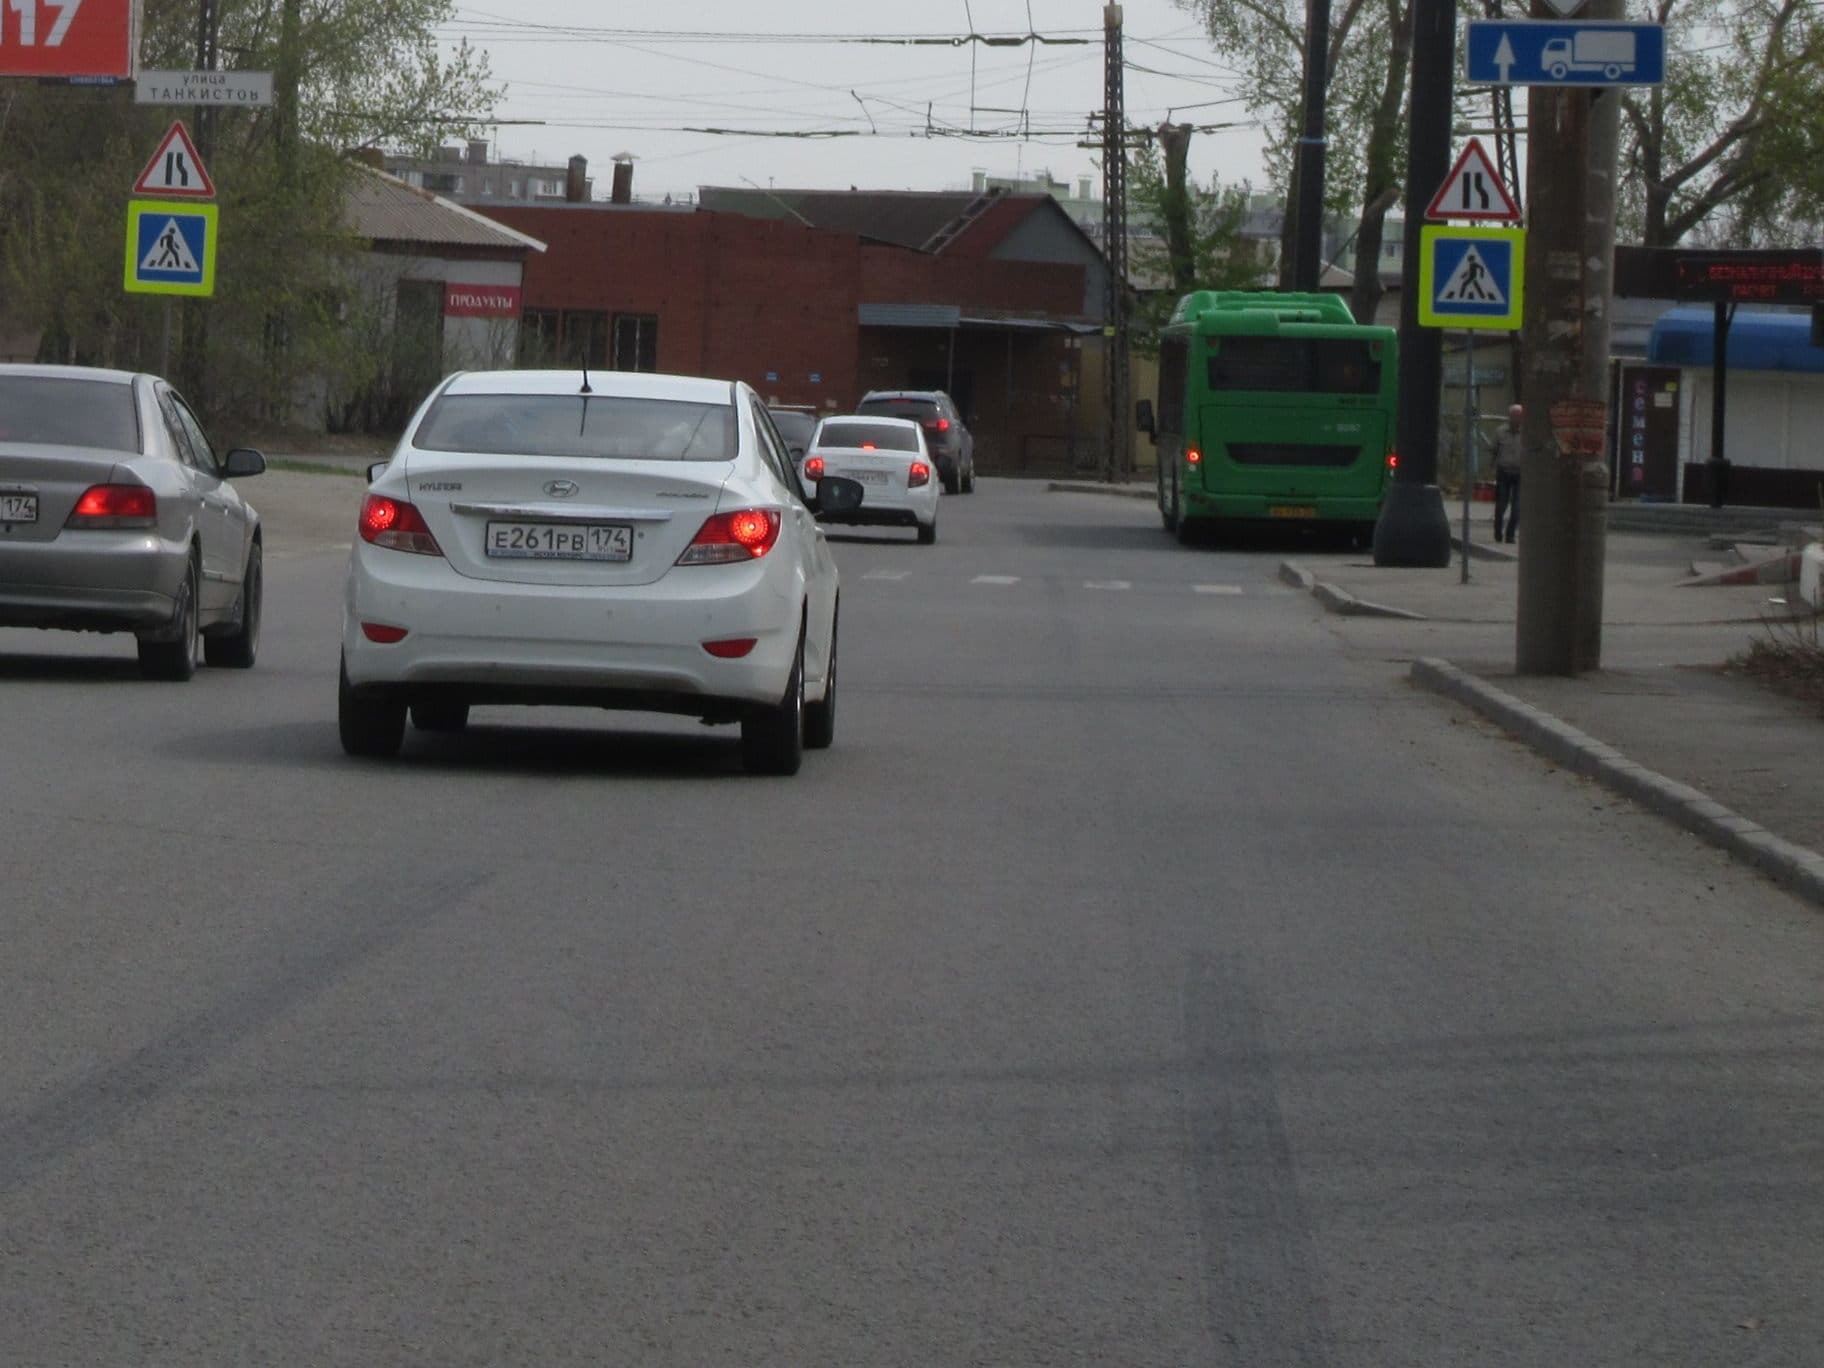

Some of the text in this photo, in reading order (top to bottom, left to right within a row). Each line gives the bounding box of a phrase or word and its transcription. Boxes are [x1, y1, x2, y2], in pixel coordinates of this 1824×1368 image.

[450, 295, 512, 309] ПРОДУКТЫ
[6, 498, 32, 513] 174
[495, 527, 626, 551] Е261РВ 174
